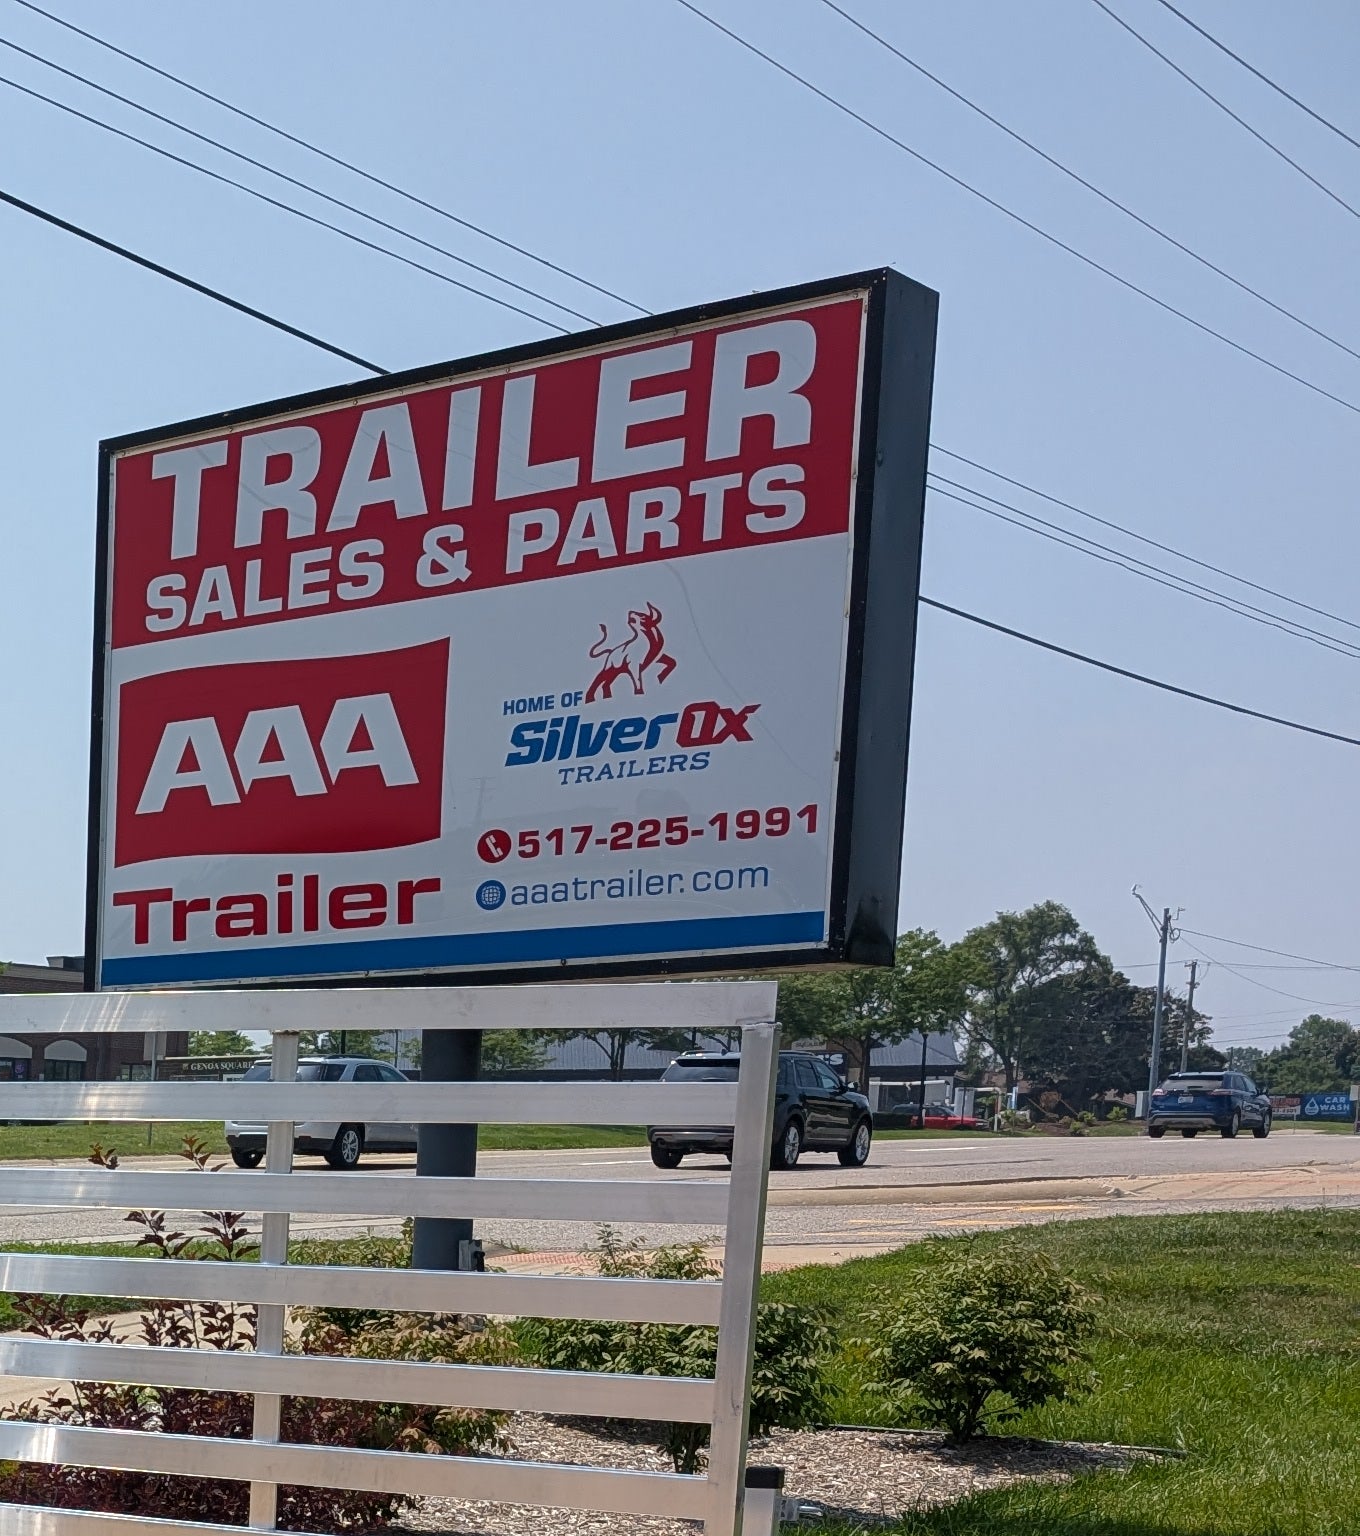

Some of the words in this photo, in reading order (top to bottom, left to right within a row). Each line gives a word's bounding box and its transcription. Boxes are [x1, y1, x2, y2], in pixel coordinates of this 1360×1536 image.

[152, 320, 817, 560] TRAILER
[145, 538, 385, 633] SALES
[415, 523, 473, 588] &
[505, 463, 807, 575] PARTS
[503, 694, 555, 716] HOME
[560, 690, 584, 708] OF
[135, 692, 420, 815] AAA
[558, 751, 711, 786] TRAILERS
[517, 803, 819, 859] 517-225-1991
[112, 873, 441, 945] Trailer
[510, 865, 769, 906] aaatrailer.com
[190, 1062, 220, 1071] GENOA
[1324, 1096, 1346, 1104] CAR
